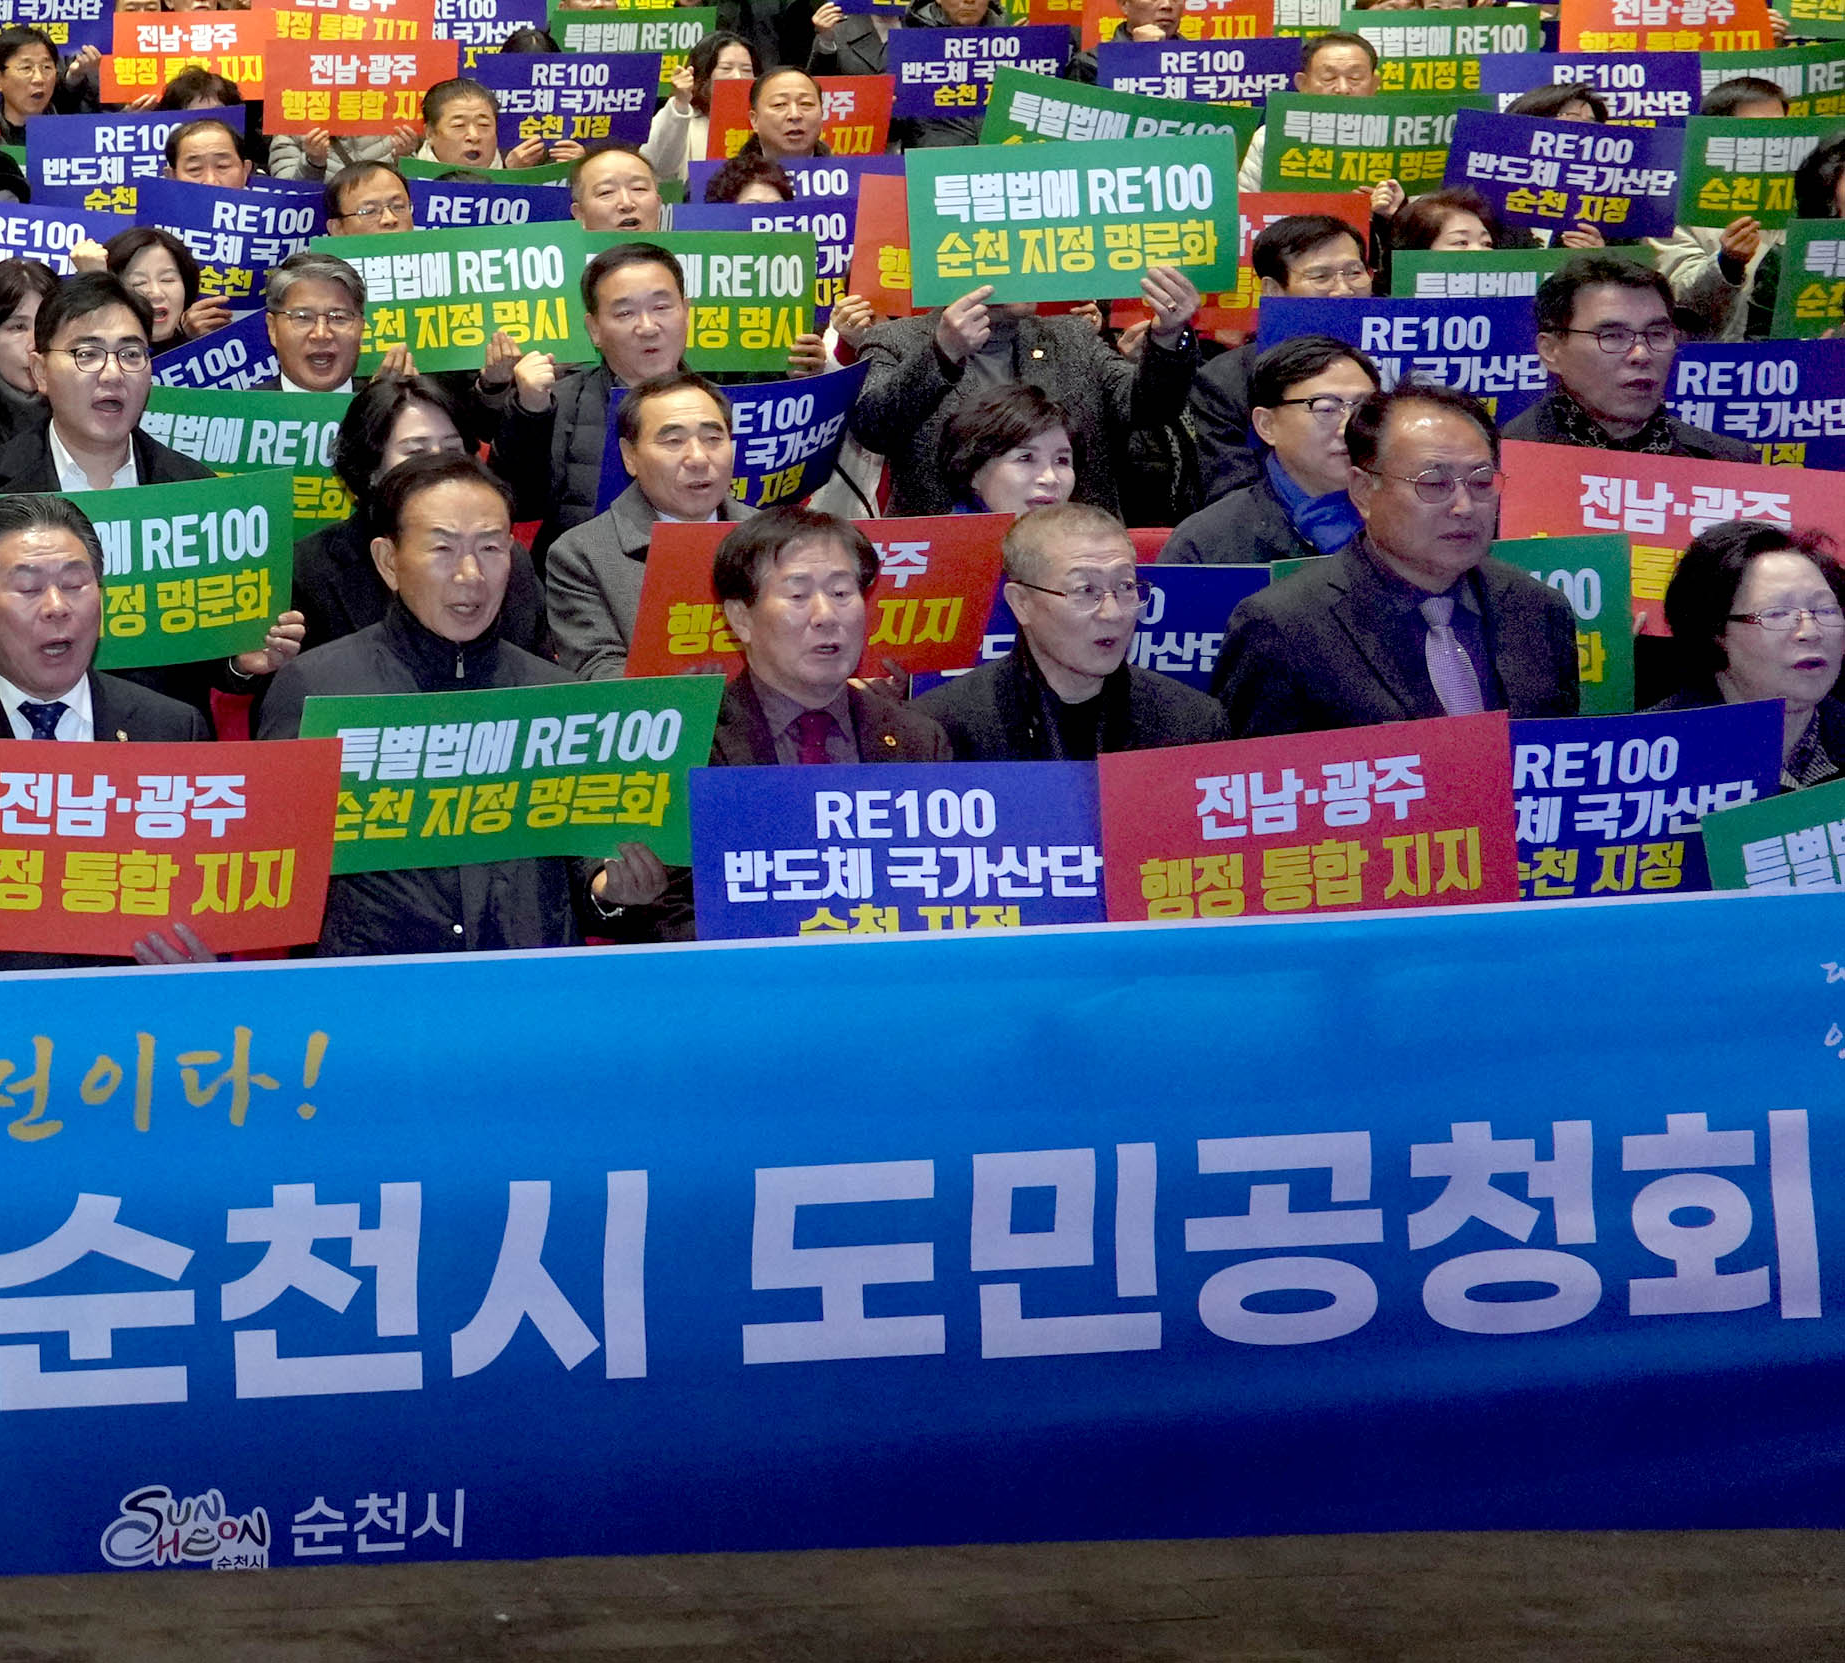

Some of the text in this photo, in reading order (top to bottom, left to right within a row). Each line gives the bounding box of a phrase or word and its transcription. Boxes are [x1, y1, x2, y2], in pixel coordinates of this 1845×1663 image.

[1467, 151, 1677, 197] 반도체 국가산단
[1530, 131, 1633, 164] RE100
[934, 164, 1212, 222] 특별법에 RE100
[1507, 188, 1630, 222] 순천 지정
[458, 245, 564, 293] RE100
[937, 220, 1217, 277] 순천 지정 명문화
[415, 298, 568, 348] 지정 명시
[1580, 475, 1791, 533] 전남·광주
[142, 505, 268, 569] RE100
[157, 568, 273, 633] 명문화
[335, 709, 682, 781] 특별법에 RE100
[1513, 736, 1679, 789] RE100
[420, 782, 519, 837] 지정
[527, 771, 670, 827] 명문화
[816, 789, 995, 839] RE100
[1196, 755, 1428, 841] 전남·광주
[61, 850, 179, 915] 통합
[191, 849, 295, 915] 지지
[725, 846, 1103, 902] 반도체 국가산단
[1140, 827, 1481, 920] 행정 통합 지지
[1593, 842, 1684, 890] 지정
[743, 1109, 1821, 1364] 도민공청회
[290, 1488, 466, 1558] 순천시
